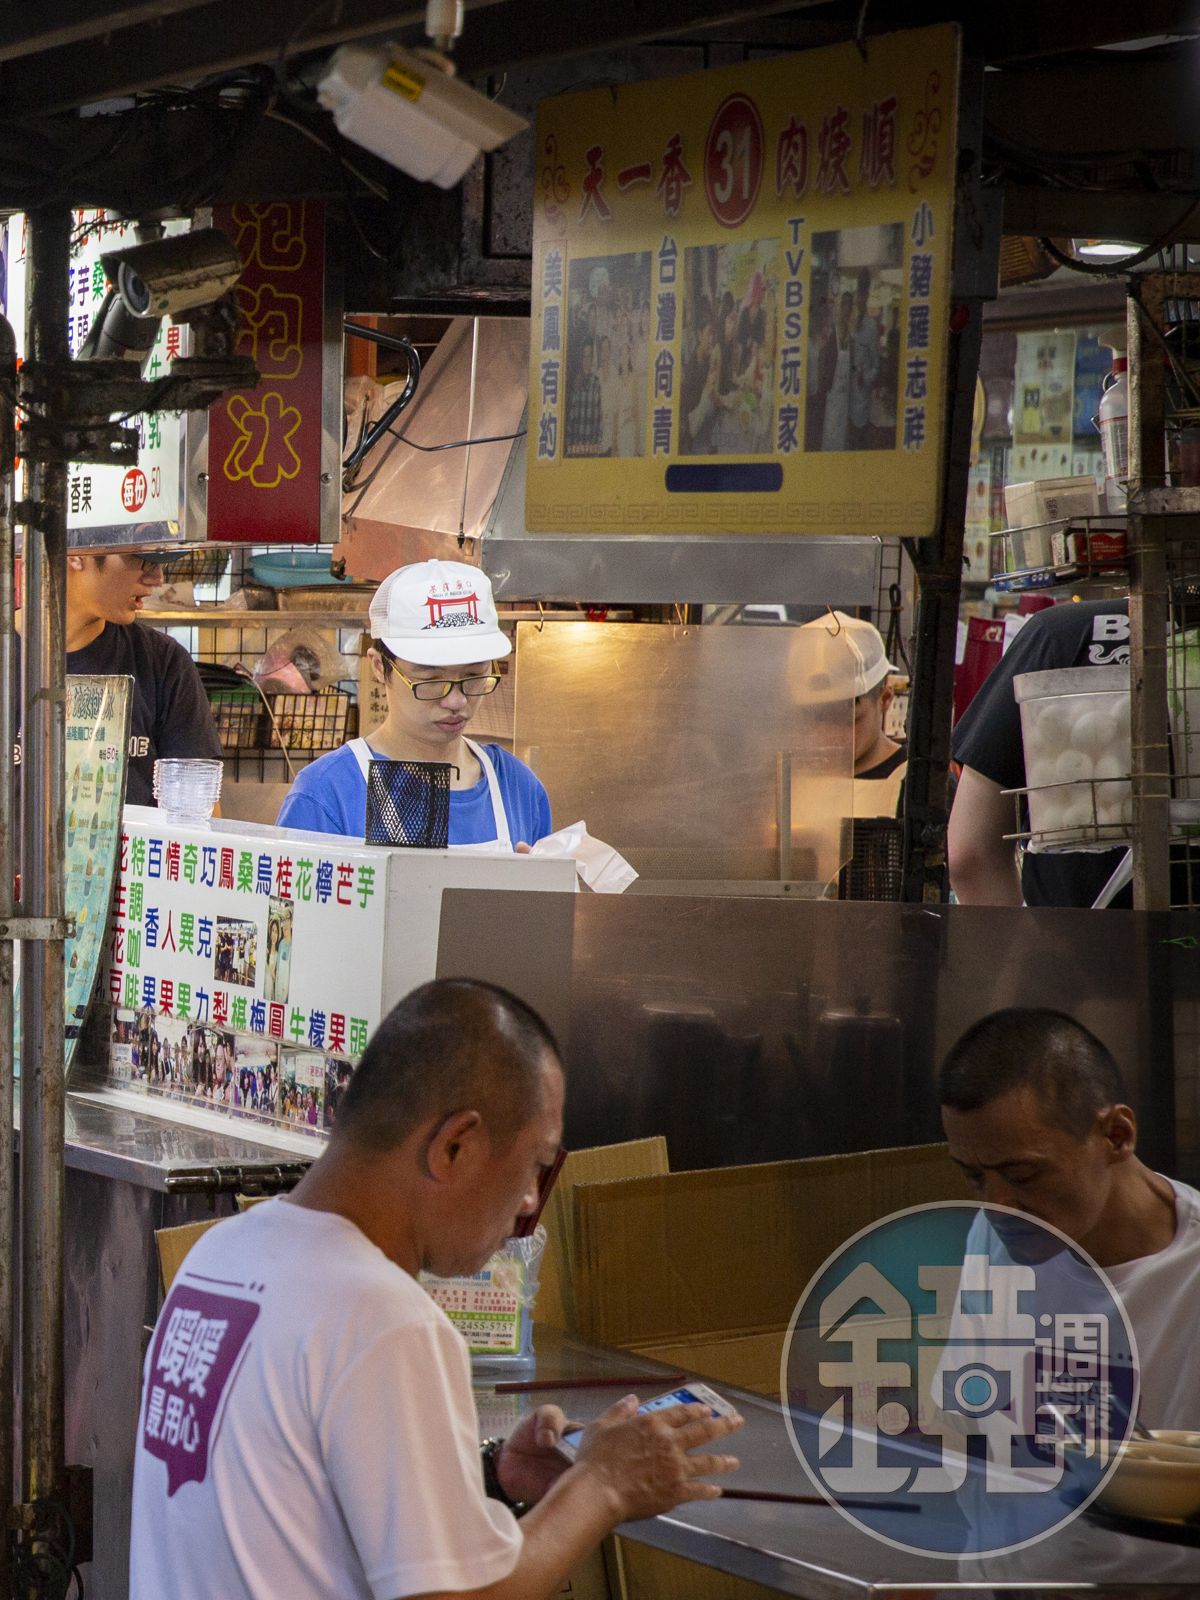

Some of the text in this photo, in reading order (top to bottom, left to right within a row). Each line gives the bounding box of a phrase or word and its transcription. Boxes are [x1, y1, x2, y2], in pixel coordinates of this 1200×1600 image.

[578, 135, 693, 222] 天一香
[713, 129, 753, 203] 31
[652, 235, 678, 458] 台灣尚青
[777, 217, 805, 454] TVBS玩家
